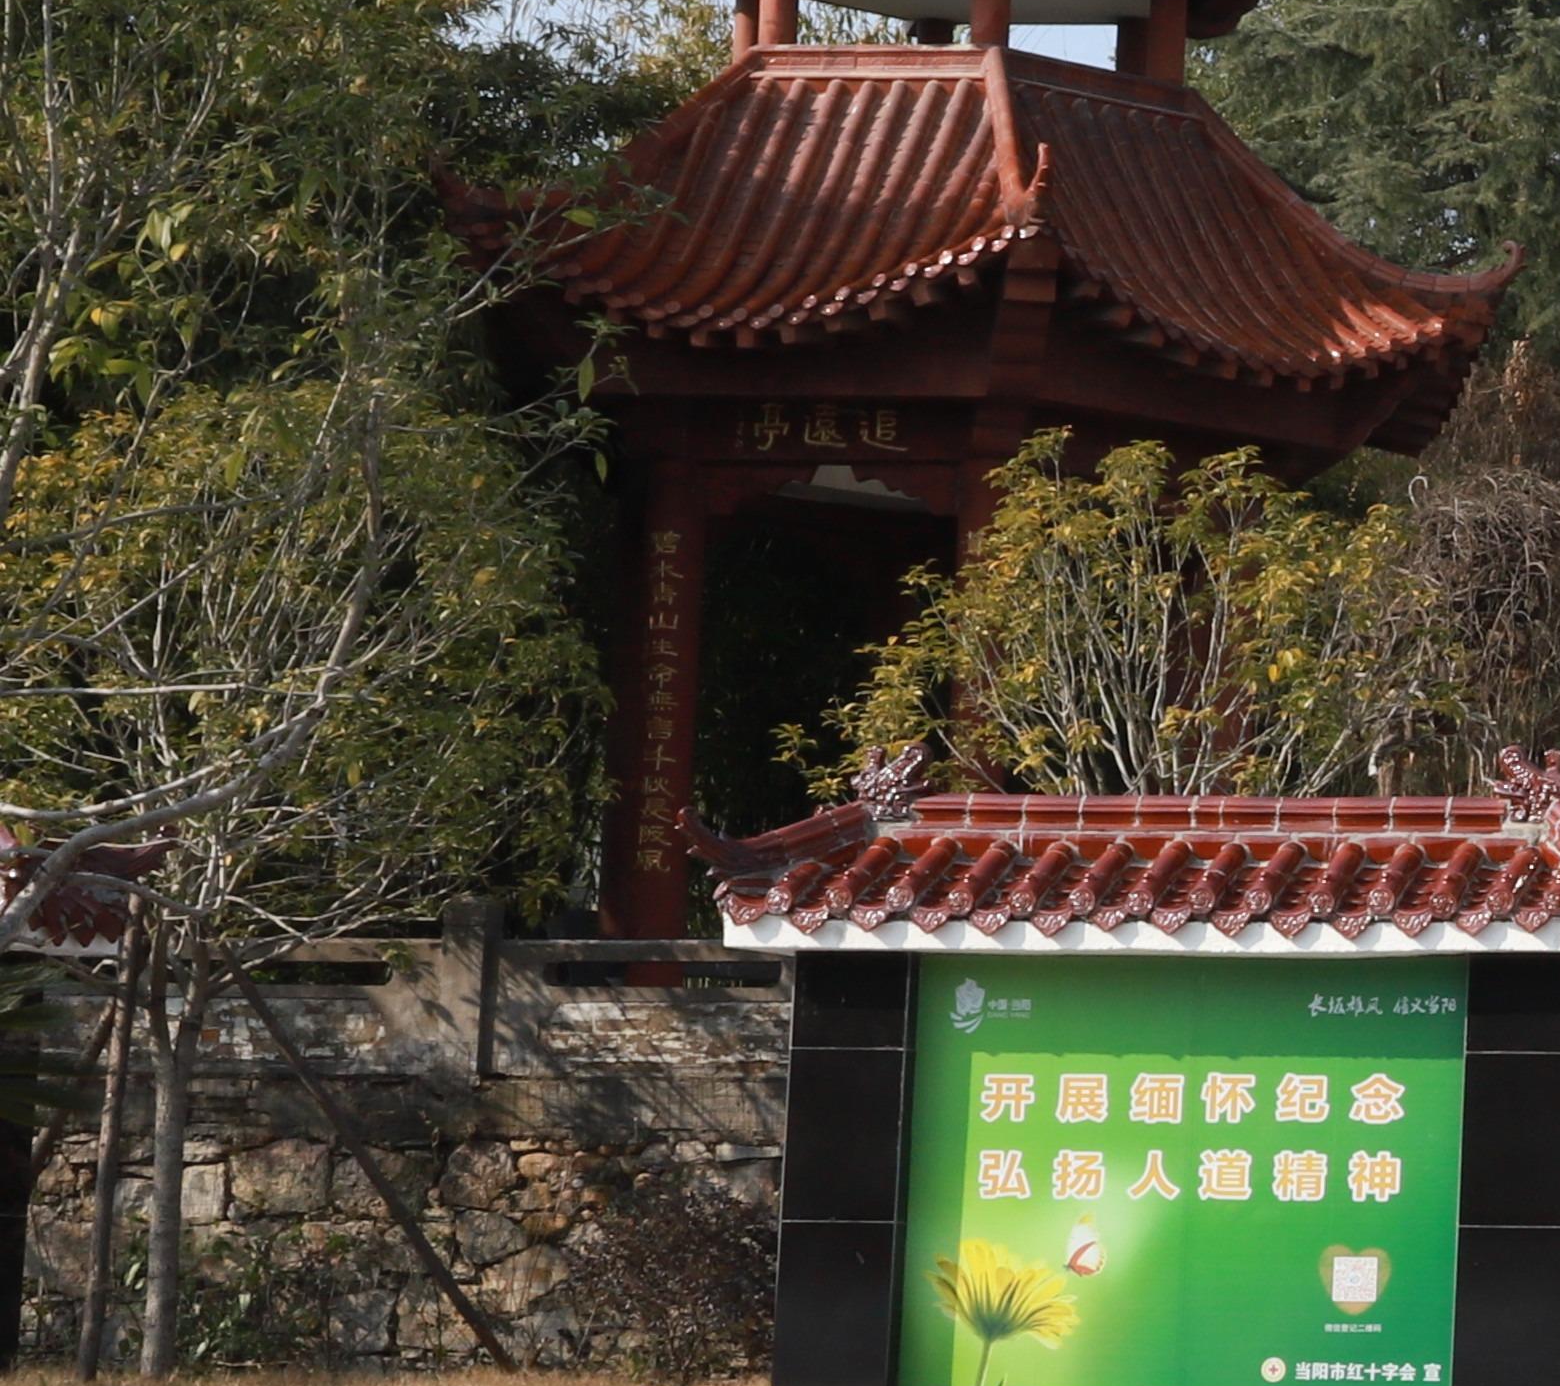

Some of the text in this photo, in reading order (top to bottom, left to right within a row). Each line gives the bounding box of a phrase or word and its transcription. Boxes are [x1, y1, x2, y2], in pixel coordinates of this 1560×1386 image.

[1393, 995, 1457, 1015] 信义当阳
[983, 1072, 1405, 1124] 开展缅怀纪念
[981, 1150, 1402, 1201] 弘扬人道精神
[1295, 1361, 1442, 1382] 当阳市红十字会 宣
